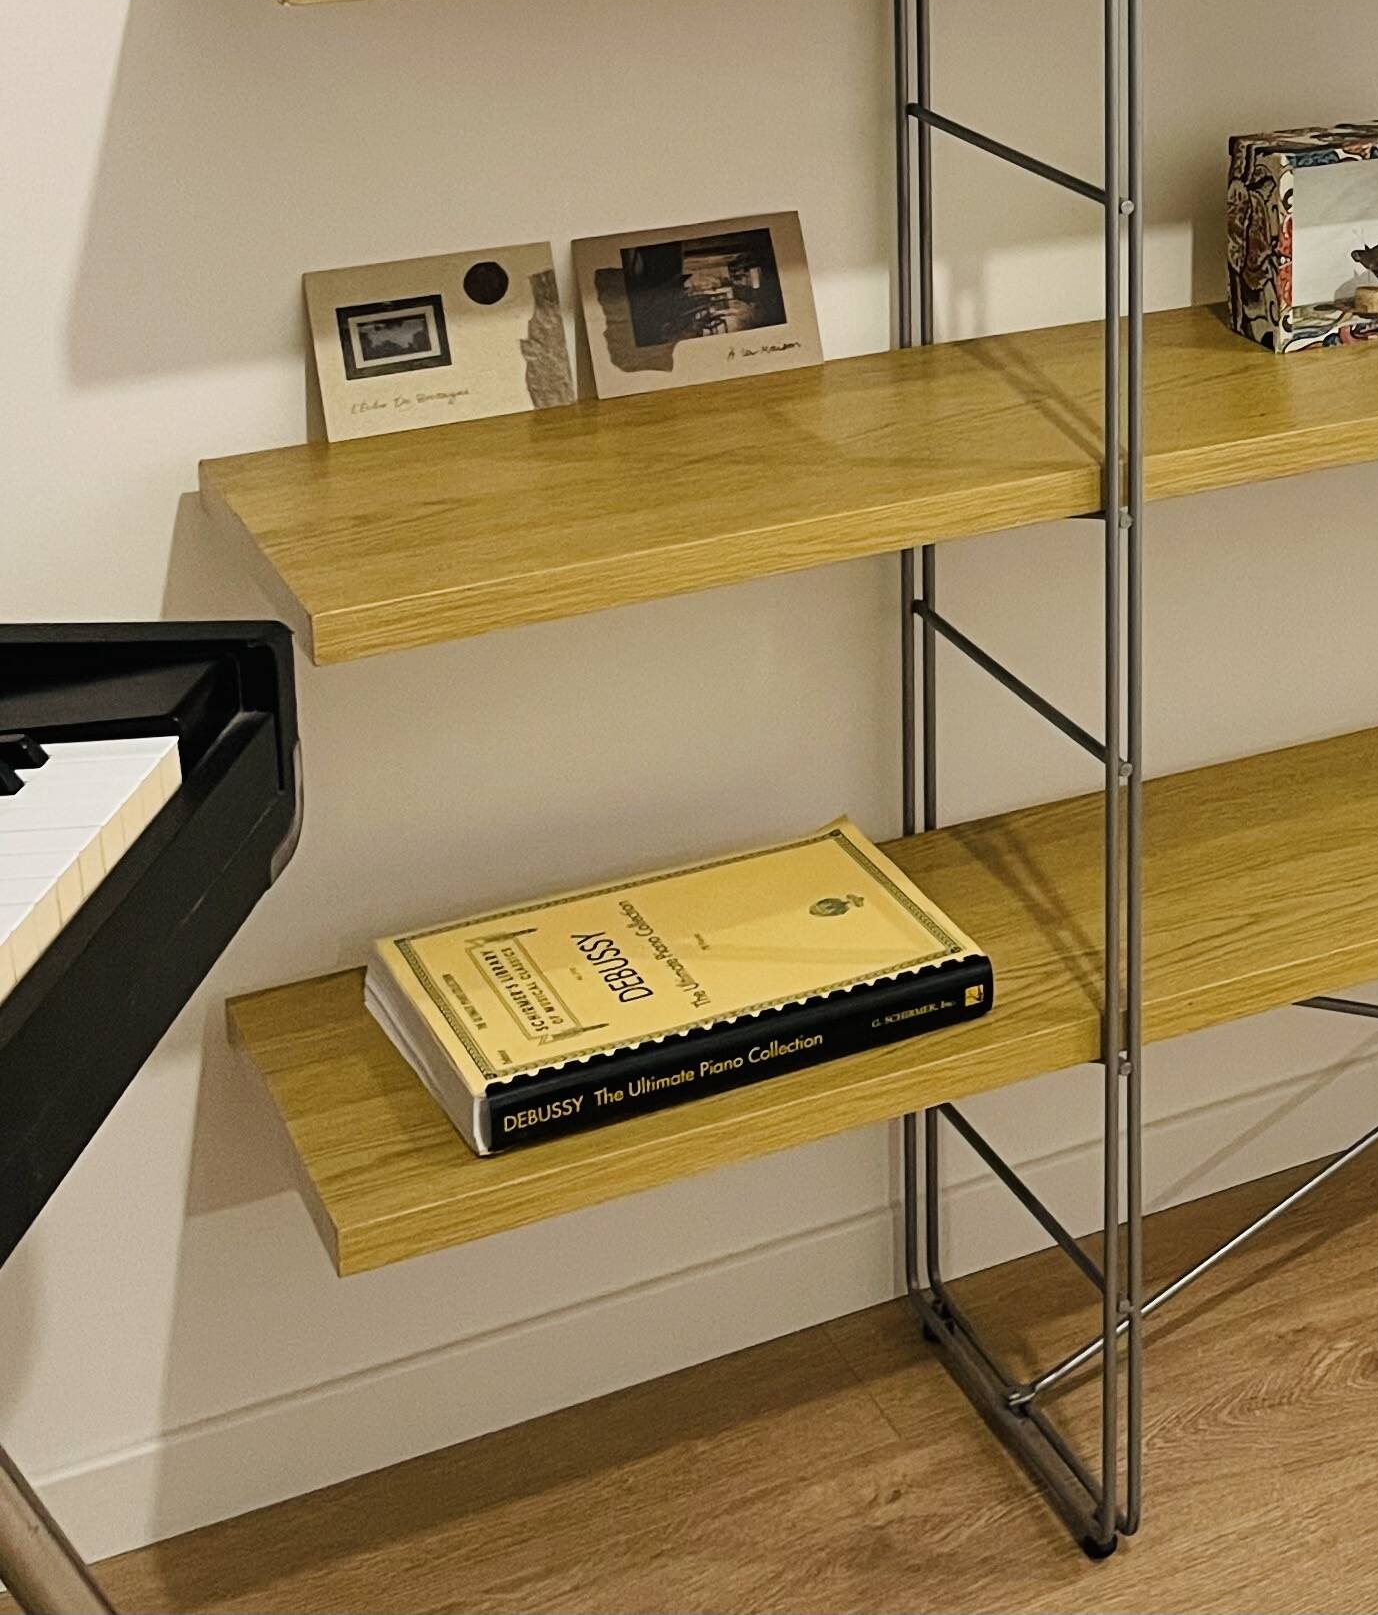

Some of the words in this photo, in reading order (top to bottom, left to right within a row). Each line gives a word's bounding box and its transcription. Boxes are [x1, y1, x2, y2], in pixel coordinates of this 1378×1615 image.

[618, 900, 654, 937] Collection
[648, 936, 673, 961] Piano
[480, 950, 514, 984] LIBRARY
[570, 932, 654, 1003] DEBUSSY
[667, 958, 700, 992] Ultimate
[505, 983, 550, 1032] SCHIRMER'S
[690, 990, 711, 1008] The
[503, 1094, 585, 1133] DEBUSSY
[594, 1087, 624, 1107] The
[628, 1069, 695, 1098] Ultimate
[699, 1057, 743, 1077] Piano
[748, 1034, 823, 1064] Collection
